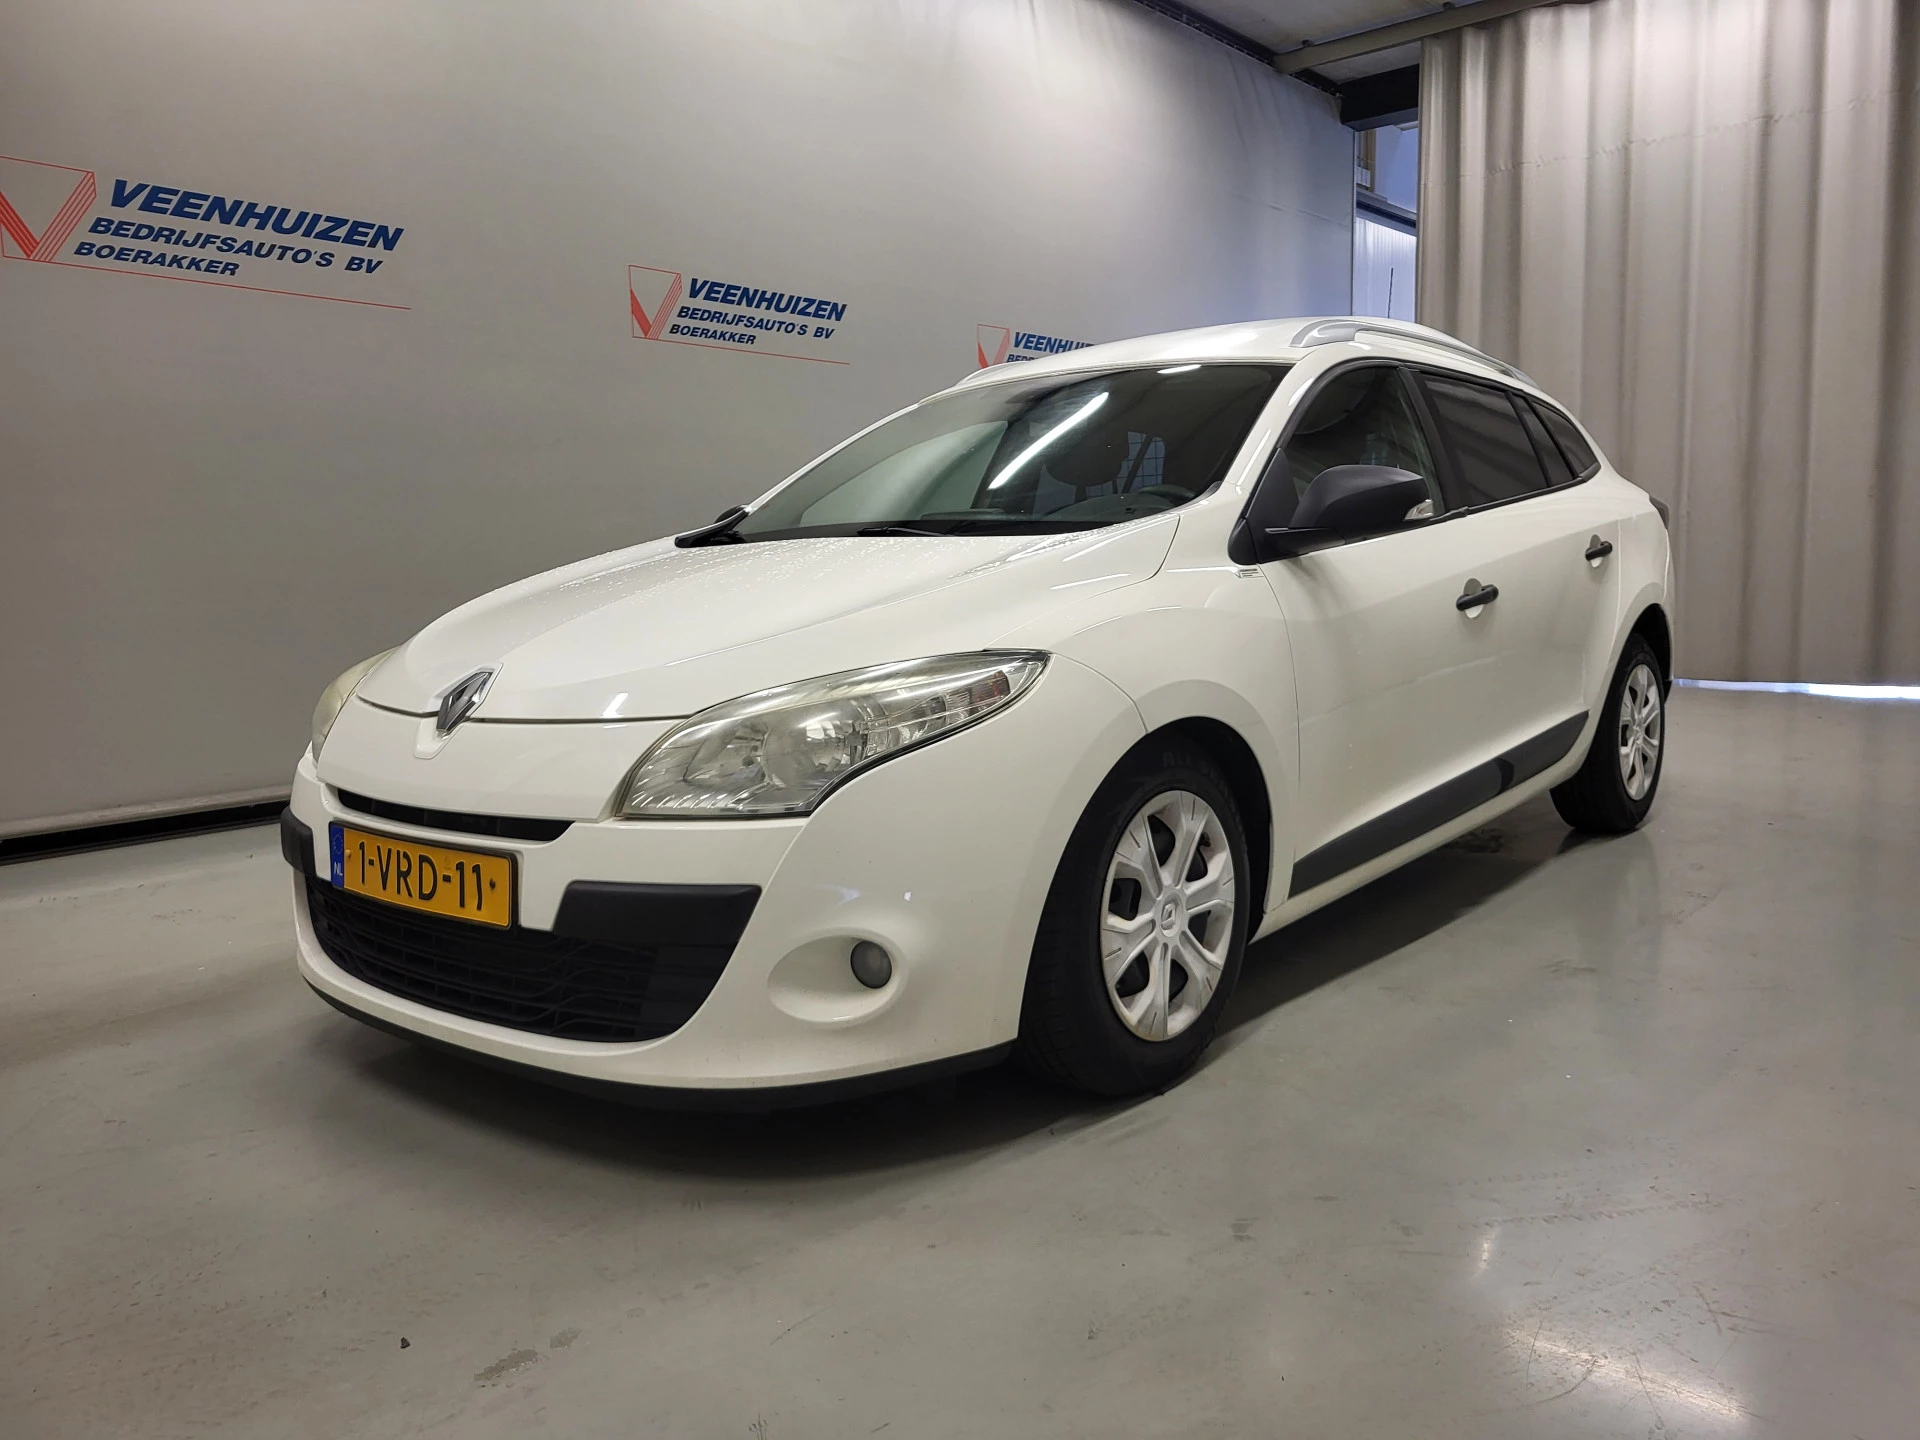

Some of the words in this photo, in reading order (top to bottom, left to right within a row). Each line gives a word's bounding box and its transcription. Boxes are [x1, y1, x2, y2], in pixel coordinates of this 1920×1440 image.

[110, 179, 404, 251] VEENHUIZEN
[73, 242, 240, 276] BOERAKKER
[88, 217, 335, 268] BEDRIJFSAUTO'S
[345, 256, 383, 274] BV
[688, 278, 847, 321] VEENHUIZEN
[669, 324, 756, 345] BOERAKKER
[677, 306, 808, 335] BEDRIJFSAUTO'S
[813, 326, 835, 339] BV
[1013, 331, 1095, 354] VEENHU
[333, 861, 344, 876] NL
[359, 841, 483, 911] 1-VRD-11
